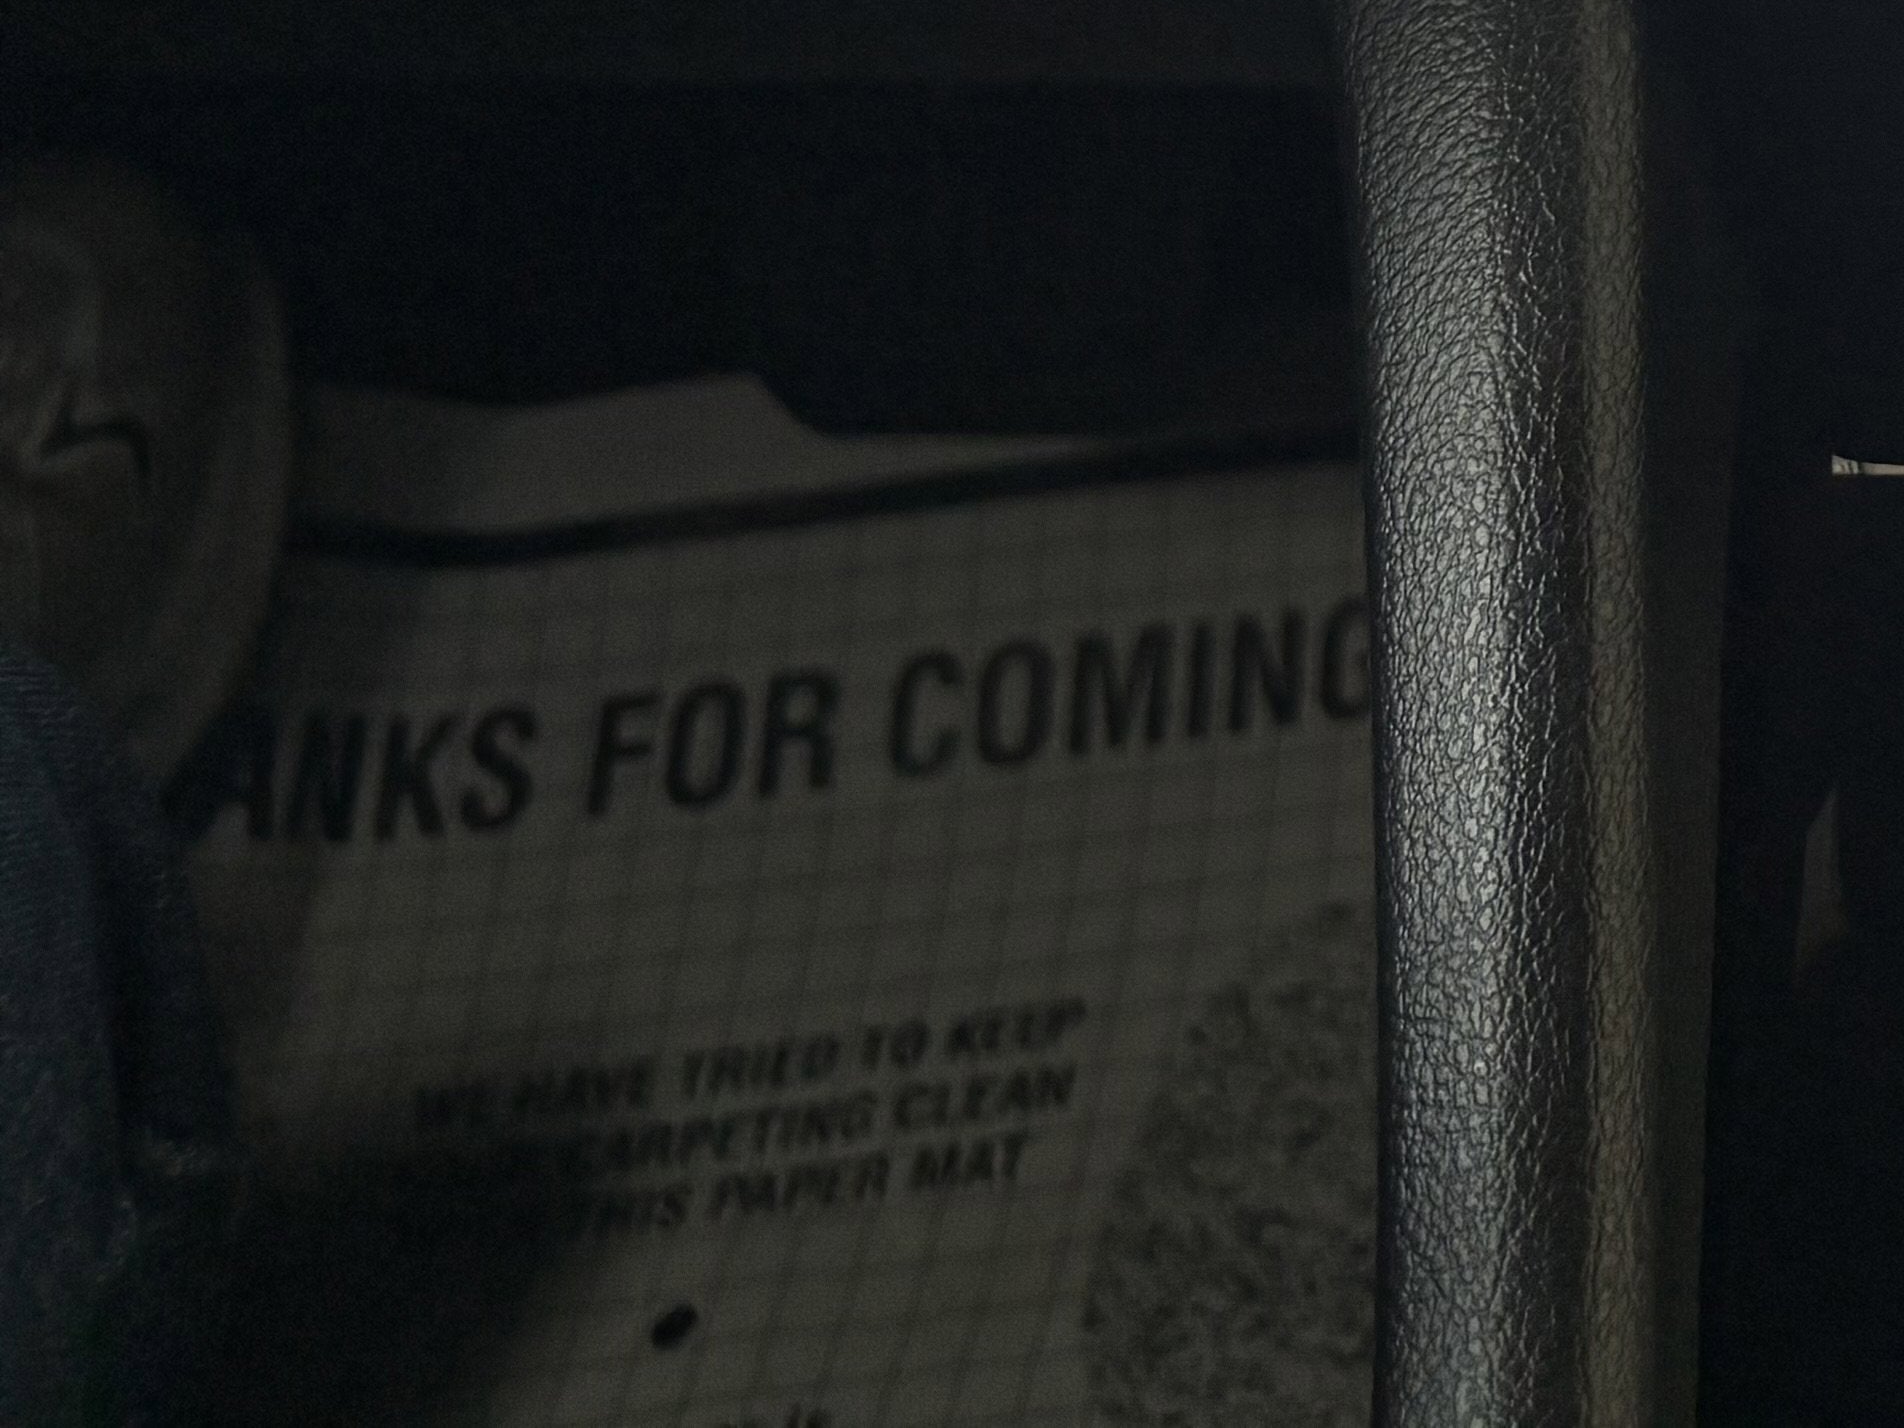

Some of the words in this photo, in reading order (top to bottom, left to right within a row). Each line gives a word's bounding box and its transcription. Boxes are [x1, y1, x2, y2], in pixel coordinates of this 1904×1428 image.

[586, 660, 843, 820] FOR
[512, 1054, 656, 1118] HAVE
[681, 1036, 842, 1101] TRIED
[860, 1018, 932, 1074] TO
[945, 994, 1088, 1064] KEEP
[892, 1059, 1077, 1134] CLEAN
[700, 1146, 893, 1223] PAPER
[904, 1128, 1029, 1194] MAT
